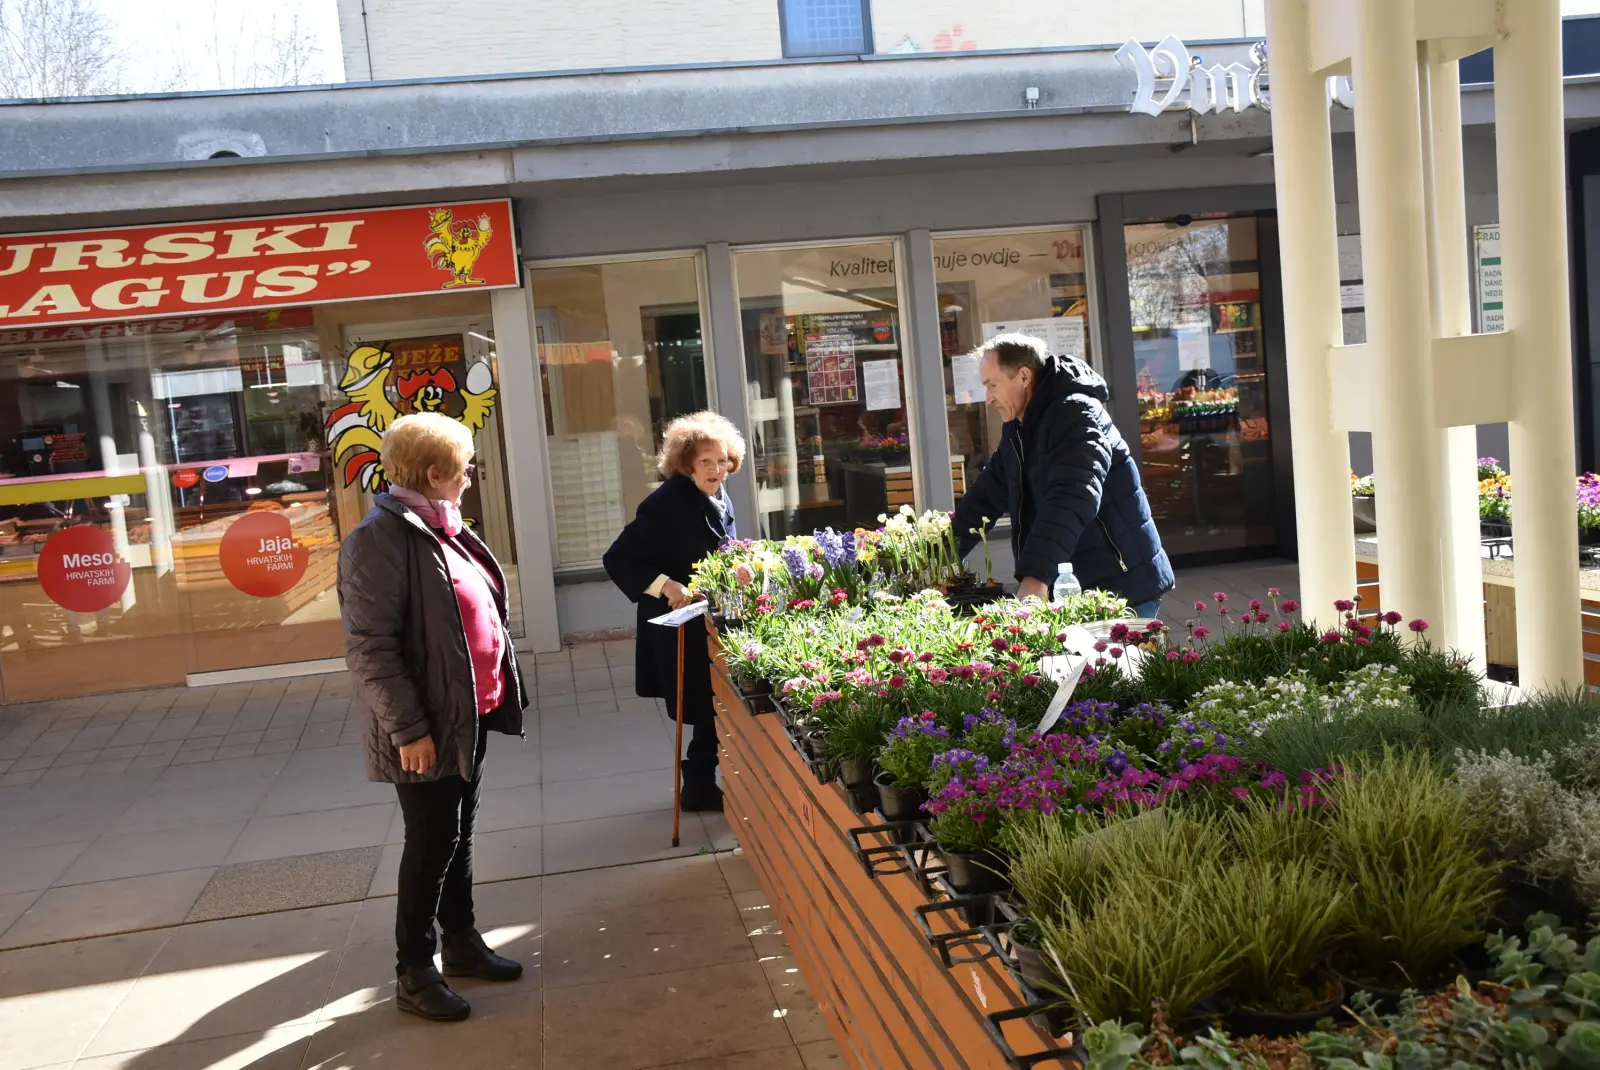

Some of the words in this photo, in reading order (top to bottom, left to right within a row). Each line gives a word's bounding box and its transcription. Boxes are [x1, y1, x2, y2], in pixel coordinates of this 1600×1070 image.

[972, 247, 1020, 268] ovdje
[0, 260, 371, 319] AGUS”
[258, 536, 292, 554] Jaja
[62, 551, 114, 569] Meso
[246, 554, 293, 566] HRVATSKIH
[266, 561, 294, 572] FARMI
[66, 569, 115, 581] HRVATSKIH
[87, 576, 116, 587] FARMI
